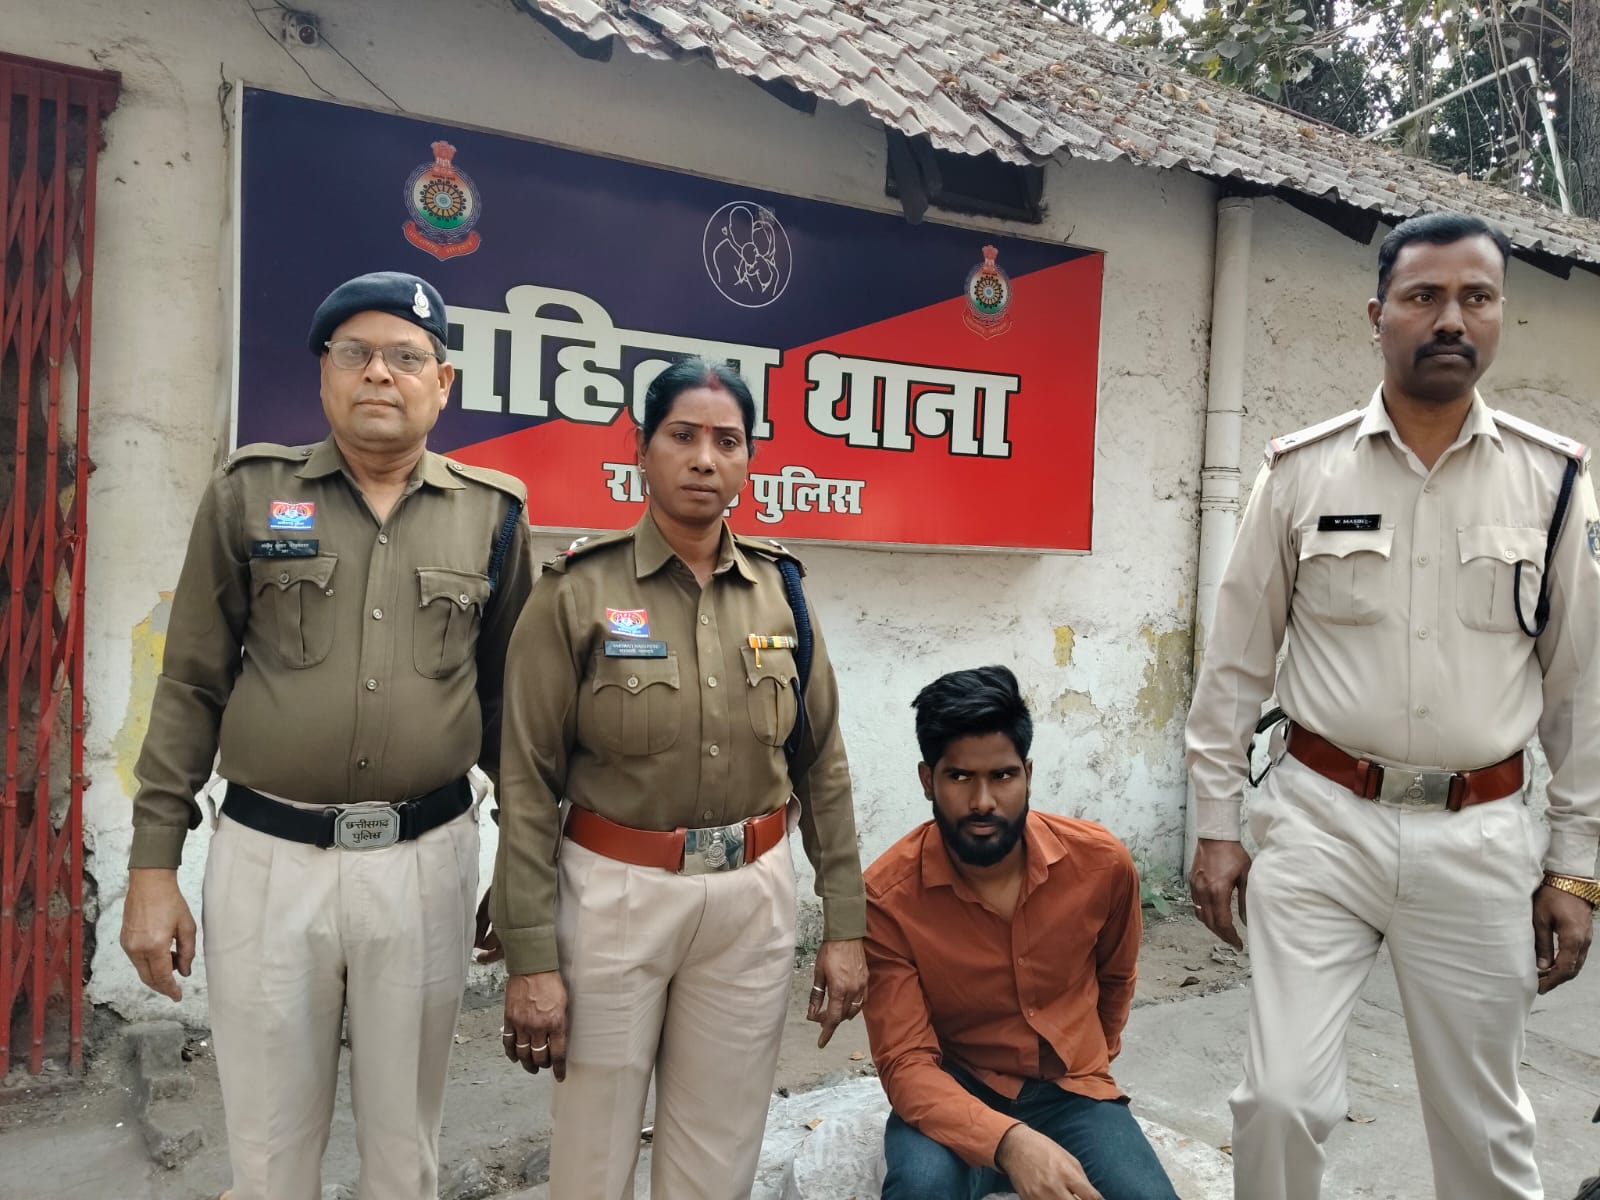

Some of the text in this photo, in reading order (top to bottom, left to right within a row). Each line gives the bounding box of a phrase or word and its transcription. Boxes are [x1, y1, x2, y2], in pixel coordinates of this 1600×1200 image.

[446, 284, 1020, 457] महिा थाना
[750, 466, 865, 523] पुलिस
[352, 830, 382, 843] पुलिस
